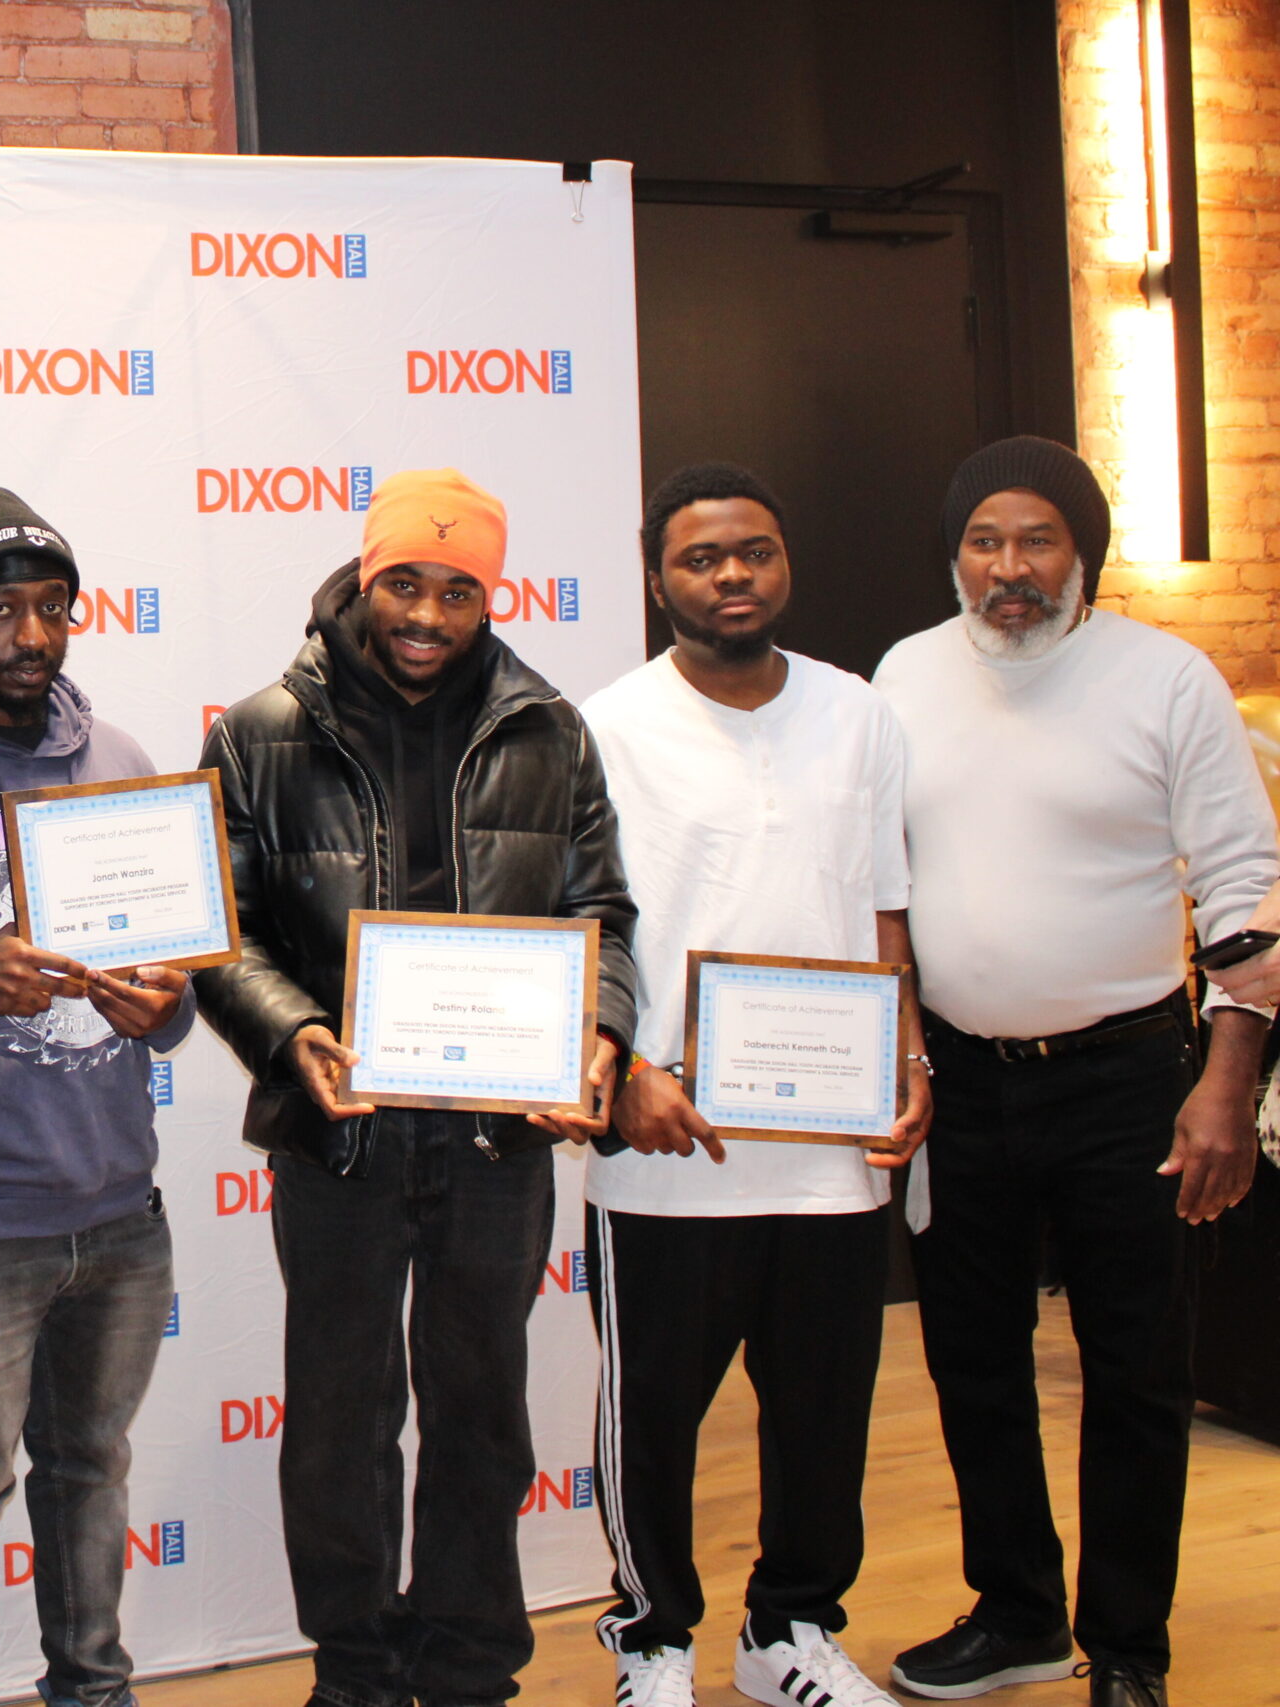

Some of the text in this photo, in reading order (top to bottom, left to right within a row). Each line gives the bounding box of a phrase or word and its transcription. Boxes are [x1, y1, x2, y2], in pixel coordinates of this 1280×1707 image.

[191, 233, 366, 279] DIXON HALL
[133, 350, 152, 394] HALL
[407, 349, 569, 394] DIXON HALL
[197, 467, 370, 513] DIXON HALL
[138, 589, 157, 633] HALL
[560, 579, 576, 621] HALL
[63, 824, 171, 845] Certificate of Achievement
[92, 867, 154, 883] Jonah Wanzira
[432, 1002, 469, 1014] Destiny
[742, 1001, 786, 1012] Certificate
[799, 1006, 854, 1017] Achievement
[743, 1040, 852, 1056] Daberechi Kenneth Osuji
[151, 1062, 170, 1105] HALL
[574, 1466, 589, 1508] HALL
[164, 1520, 182, 1564] HALL
